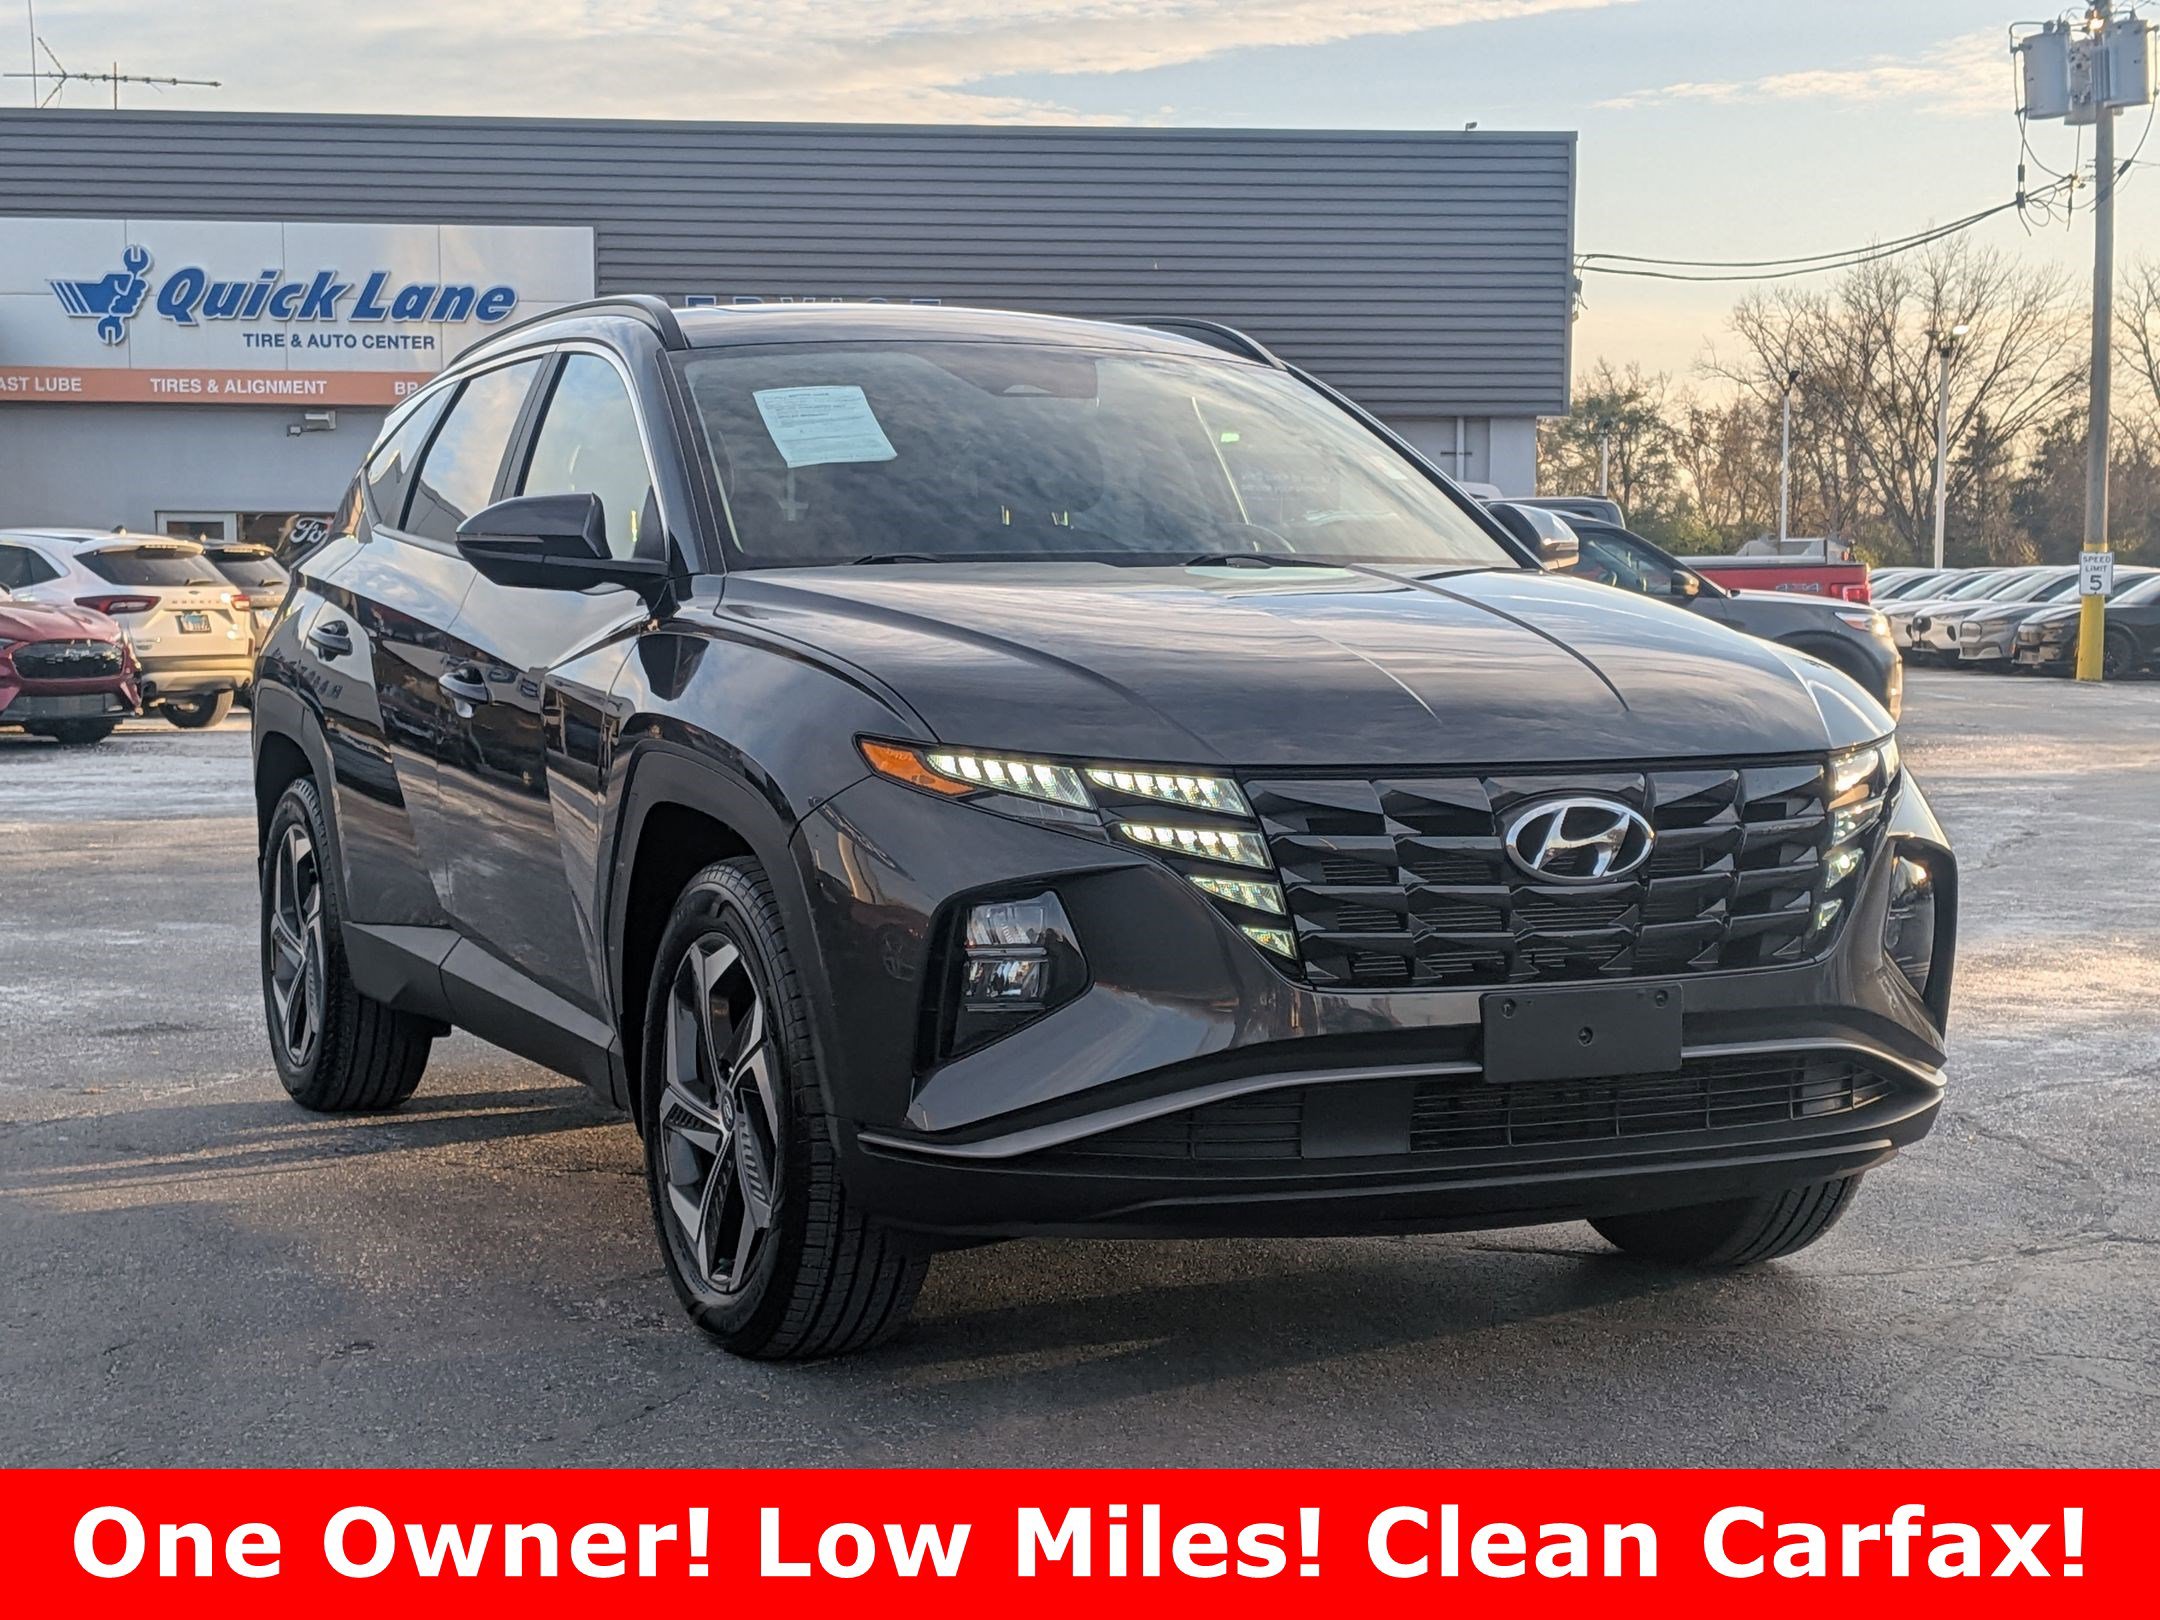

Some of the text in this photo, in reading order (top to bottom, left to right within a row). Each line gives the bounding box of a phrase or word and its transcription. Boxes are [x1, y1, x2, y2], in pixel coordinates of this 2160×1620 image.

[156, 266, 518, 325] Quick Lane
[243, 333, 435, 350] TIRE & AUTO CENTER
[34, 376, 82, 392] LUBE
[150, 377, 327, 395] TIRES & ALIGNMENT
[2082, 555, 2111, 563] SPEED
[2085, 564, 2107, 572] LIMIT
[2089, 574, 2103, 591] 5
